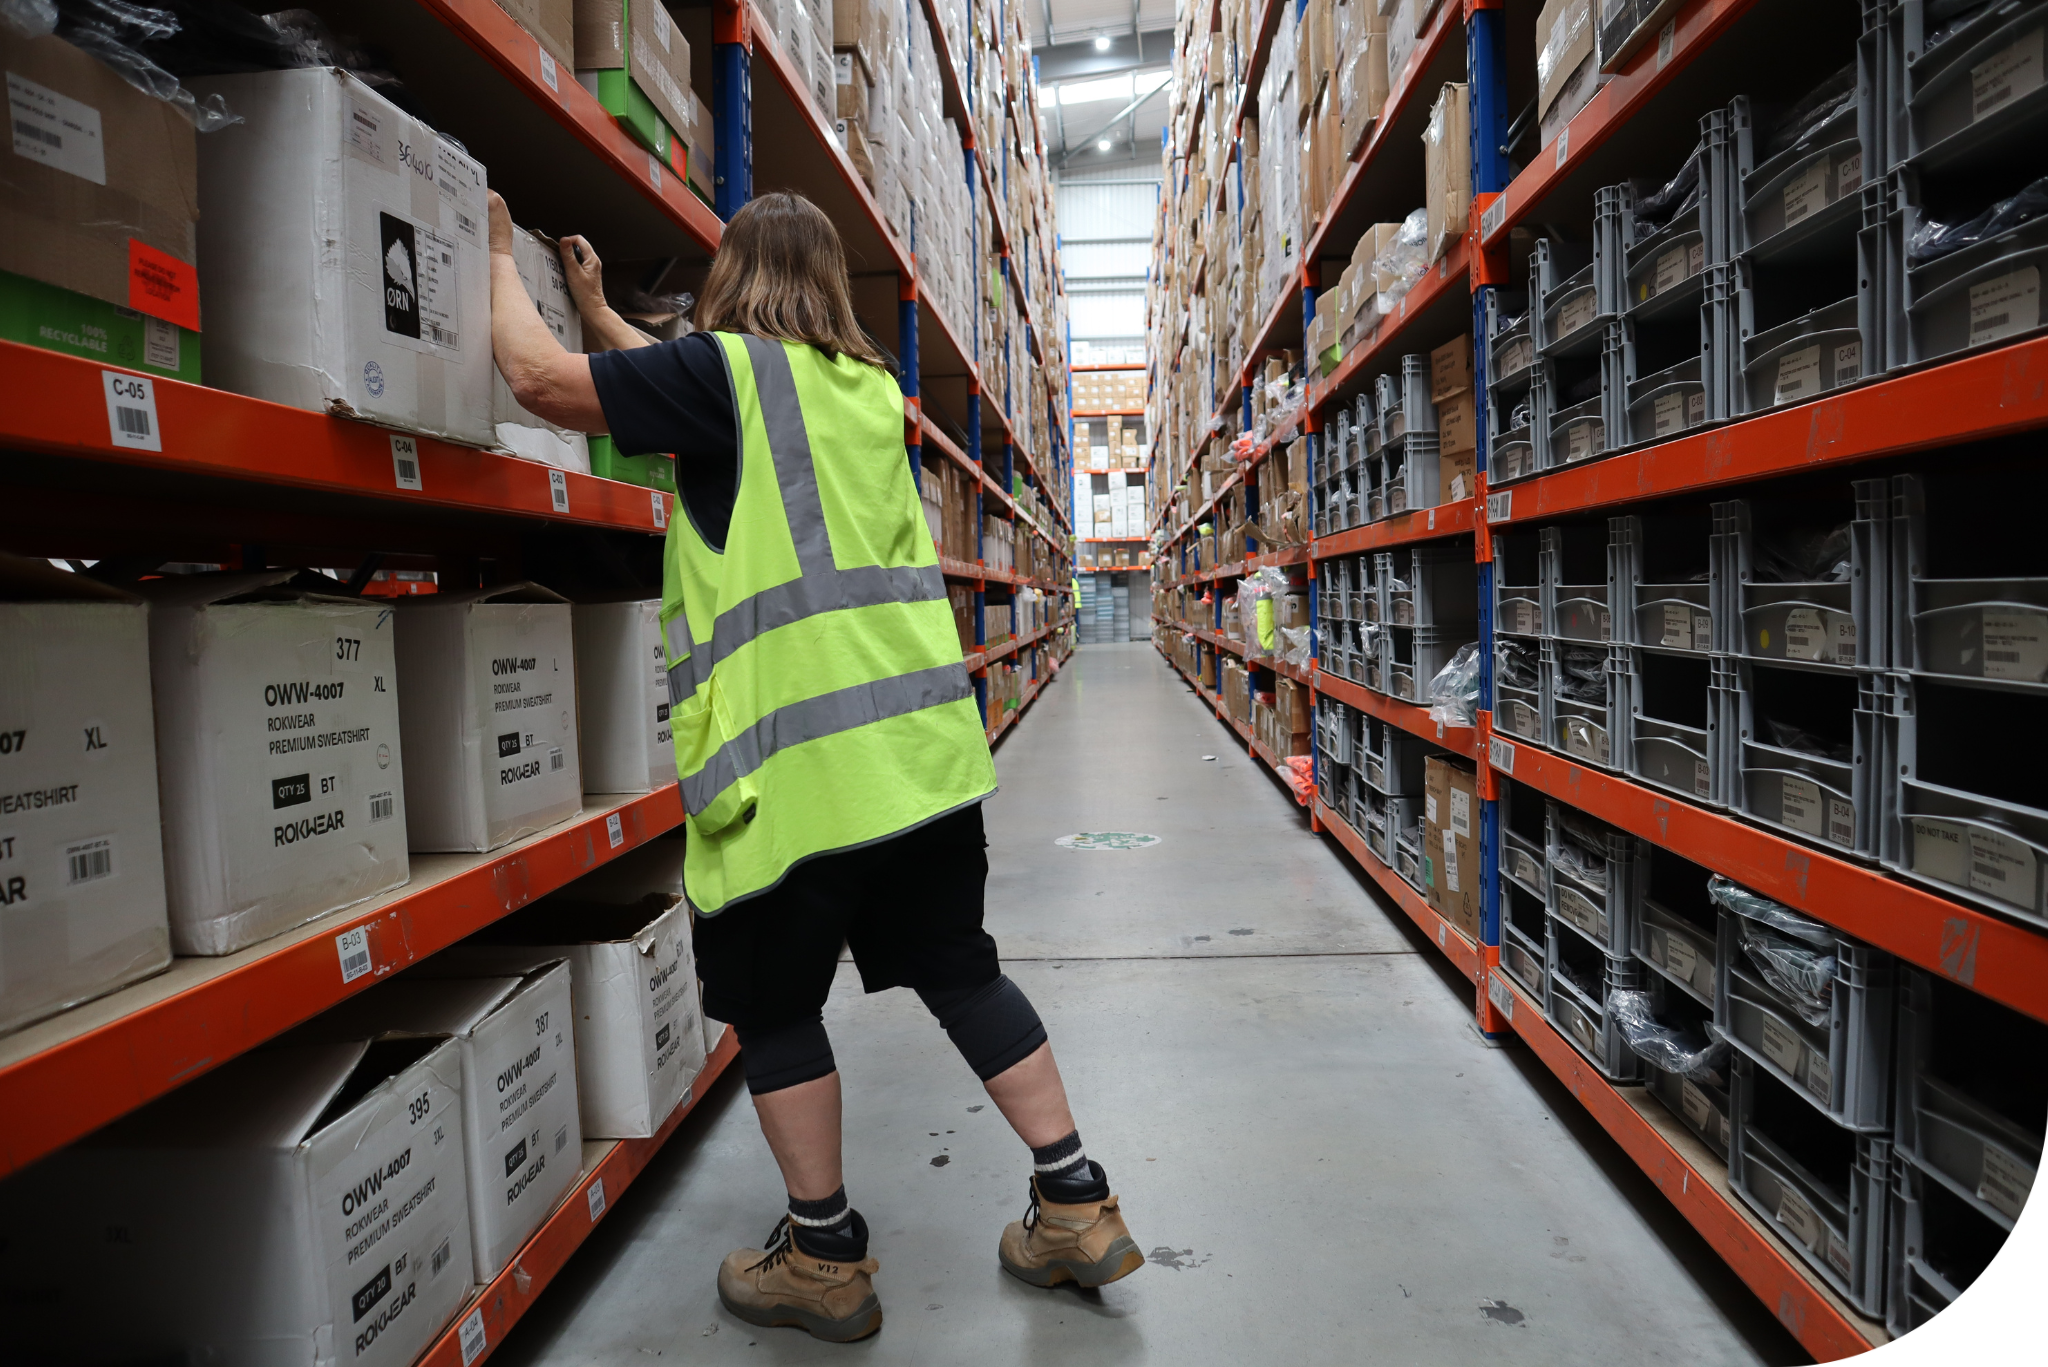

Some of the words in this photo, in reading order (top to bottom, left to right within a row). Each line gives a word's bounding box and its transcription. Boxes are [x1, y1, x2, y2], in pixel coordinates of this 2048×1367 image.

[1843, 158, 1859, 176] C-10
[386, 287, 409, 312] ØRN
[39, 325, 108, 353] RECYCLABLE
[81, 323, 107, 341] 100%
[1840, 346, 1856, 362] C-04
[113, 379, 145, 400] C-05
[395, 439, 412, 454] C-04
[551, 473, 563, 485] C-03
[1840, 624, 1856, 637] B-10
[336, 637, 361, 662] 377
[492, 657, 536, 676] OWW-4007
[553, 658, 559, 672] L
[264, 681, 345, 708] OWW-4007
[373, 675, 386, 693] XL
[493, 682, 521, 695] ROKWEAR
[495, 697, 522, 713] PREMIUM
[523, 693, 552, 710] SWEATSHIRT
[267, 712, 315, 733] ROKWEAR
[85, 726, 108, 752] XL
[269, 736, 316, 756] PREMIUM
[317, 728, 370, 751] SWEATSHIRT
[501, 739, 511, 750] QTY
[511, 738, 518, 748] 25
[525, 734, 533, 747] BT
[501, 761, 540, 786] ROKWEAR
[278, 783, 295, 798] QTY
[295, 782, 305, 795] 25
[321, 776, 335, 794] BT
[1834, 803, 1850, 819] B-04
[274, 809, 345, 847] ROKWEAR
[1916, 824, 1925, 835] DO
[1927, 827, 1940, 839] NOT
[1942, 830, 1959, 843] TAKE
[342, 931, 361, 950] B-03
[650, 960, 678, 992] OWW-4007
[652, 987, 672, 1008] ROKWEAR
[535, 1011, 549, 1037] 387
[657, 1036, 680, 1070] ROKWEAR
[497, 1046, 541, 1093] OWW-4007
[409, 1091, 430, 1126] 395
[500, 1083, 527, 1113] ROKWEAR
[502, 1102, 528, 1132] PREMIUM
[528, 1073, 557, 1109] SWEATSHIRT
[434, 1125, 445, 1146] 3XL
[508, 1152, 517, 1167] QTY
[531, 1128, 540, 1148] BT
[341, 1148, 412, 1217] OWW-4007
[507, 1154, 545, 1207] ROKWEAR
[345, 1199, 389, 1242] ROKWEAR
[348, 1220, 390, 1265] PREMIUM
[392, 1177, 436, 1228] SWEATSHIRT
[358, 1289, 375, 1309] QTY
[395, 1252, 407, 1276] BT
[818, 1262, 839, 1274] V12
[355, 1282, 416, 1356] ROKWEAR
[464, 1316, 478, 1339] A-04
